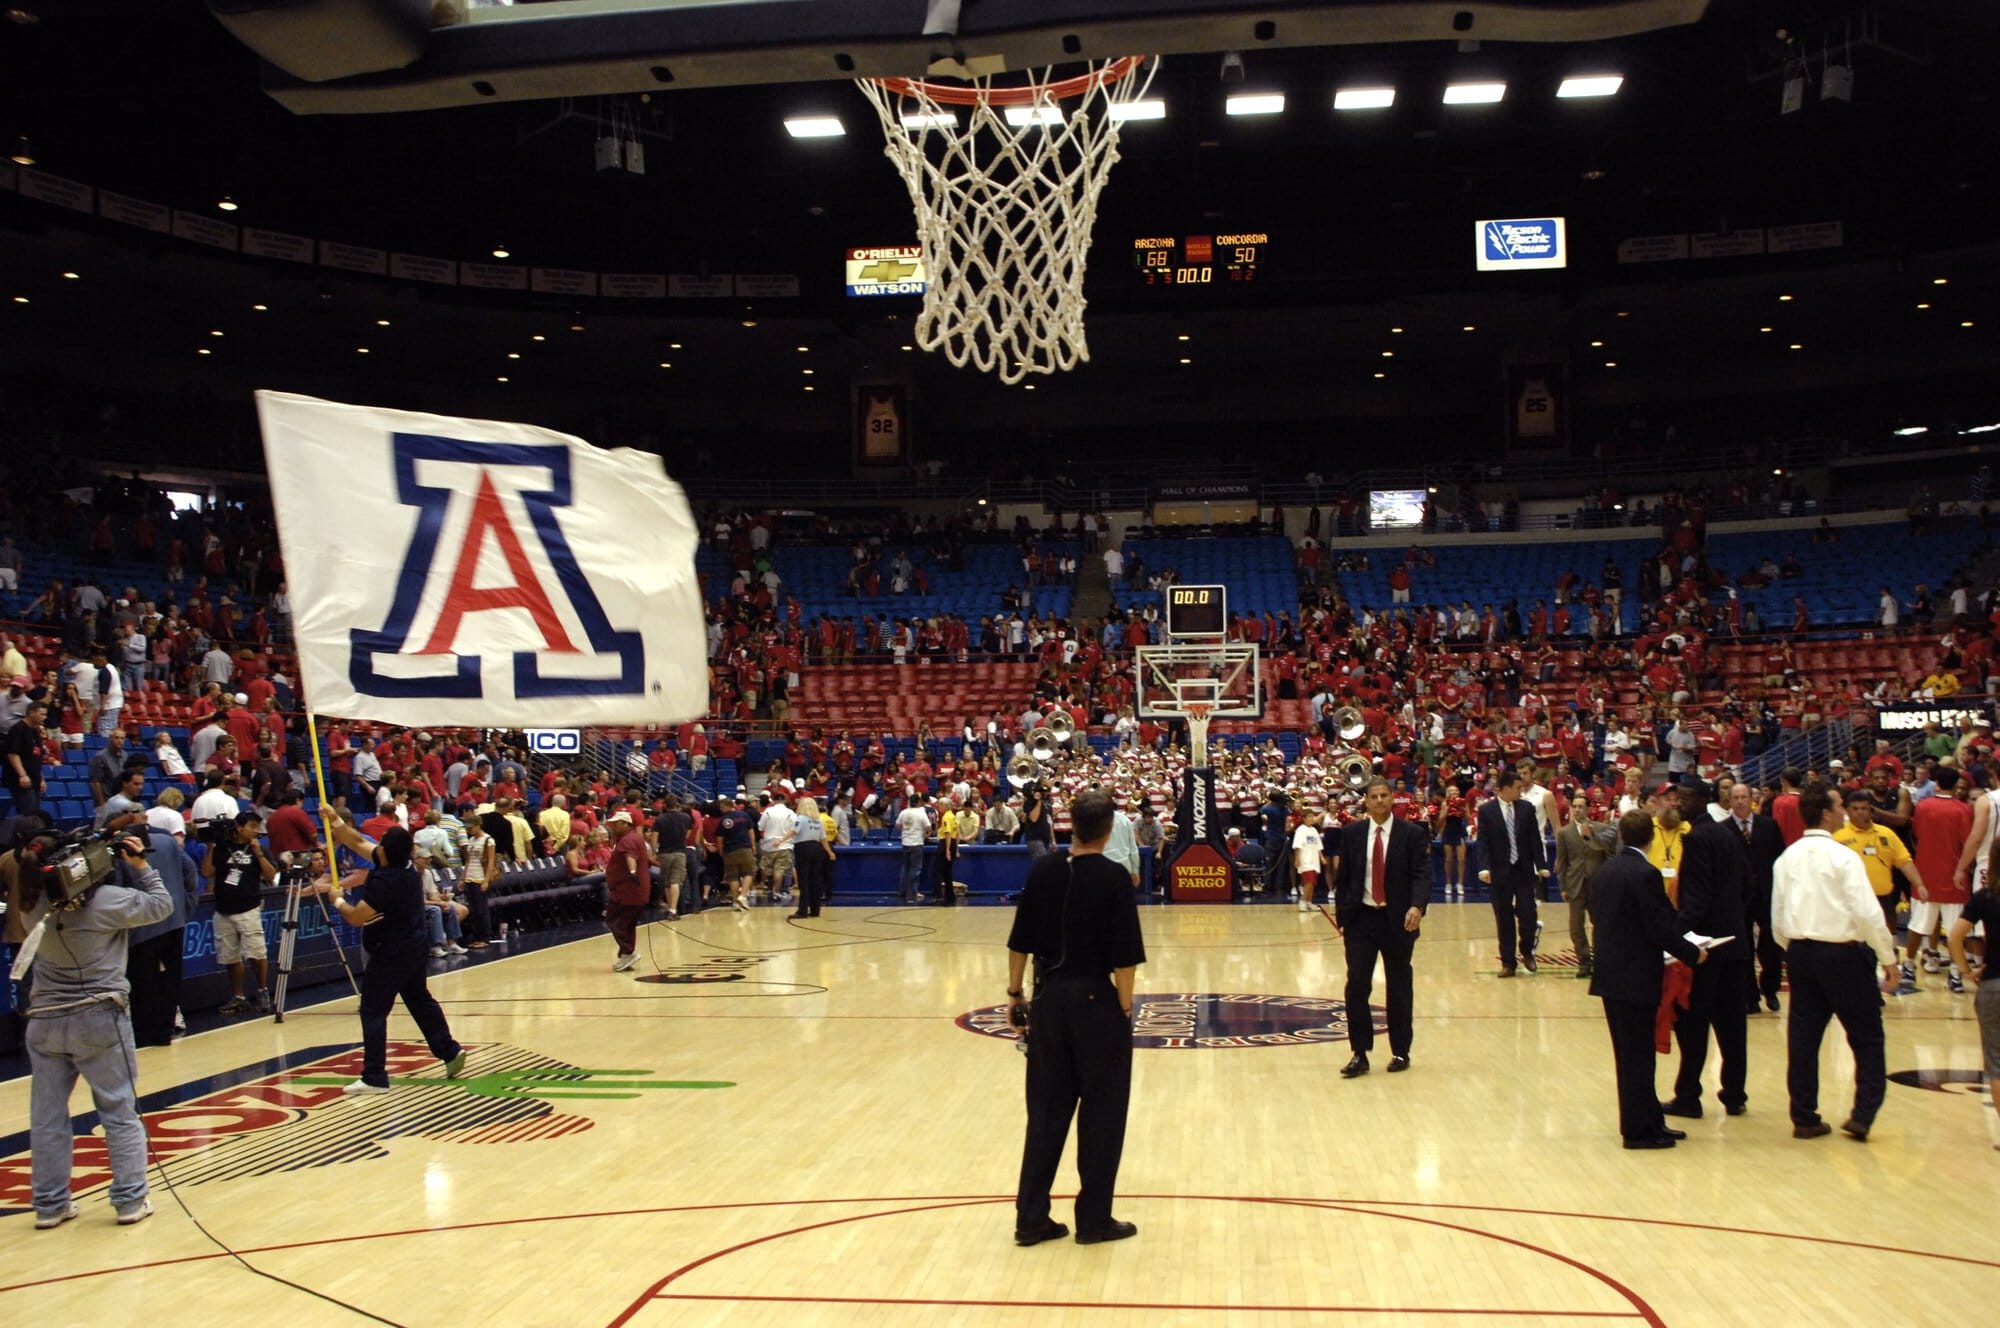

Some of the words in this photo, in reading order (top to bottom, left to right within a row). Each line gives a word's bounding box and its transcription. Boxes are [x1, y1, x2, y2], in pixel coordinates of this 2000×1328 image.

[1502, 225, 1541, 236] Tucson
[1135, 239, 1174, 248] ARIZONA
[1216, 235, 1267, 245] CONCORDIA
[1506, 234, 1550, 244] Electric
[853, 248, 921, 260] O'RIELLY
[1235, 248, 1255, 263] 50
[1511, 245, 1551, 255] Power
[1177, 267, 1212, 284] 00.0
[854, 283, 923, 296] WATSON
[872, 419, 893, 434] 32
[1162, 487, 1183, 495] HALL
[1199, 485, 1248, 494] CHAMPIONS
[350, 432, 645, 699] A
[1174, 590, 1209, 604] 00.0
[1193, 773, 1207, 840] ARIZONA
[1176, 866, 1226, 876] WELLS
[1177, 877, 1226, 889] FARGO
[1132, 1001, 1198, 1037] OLSON
